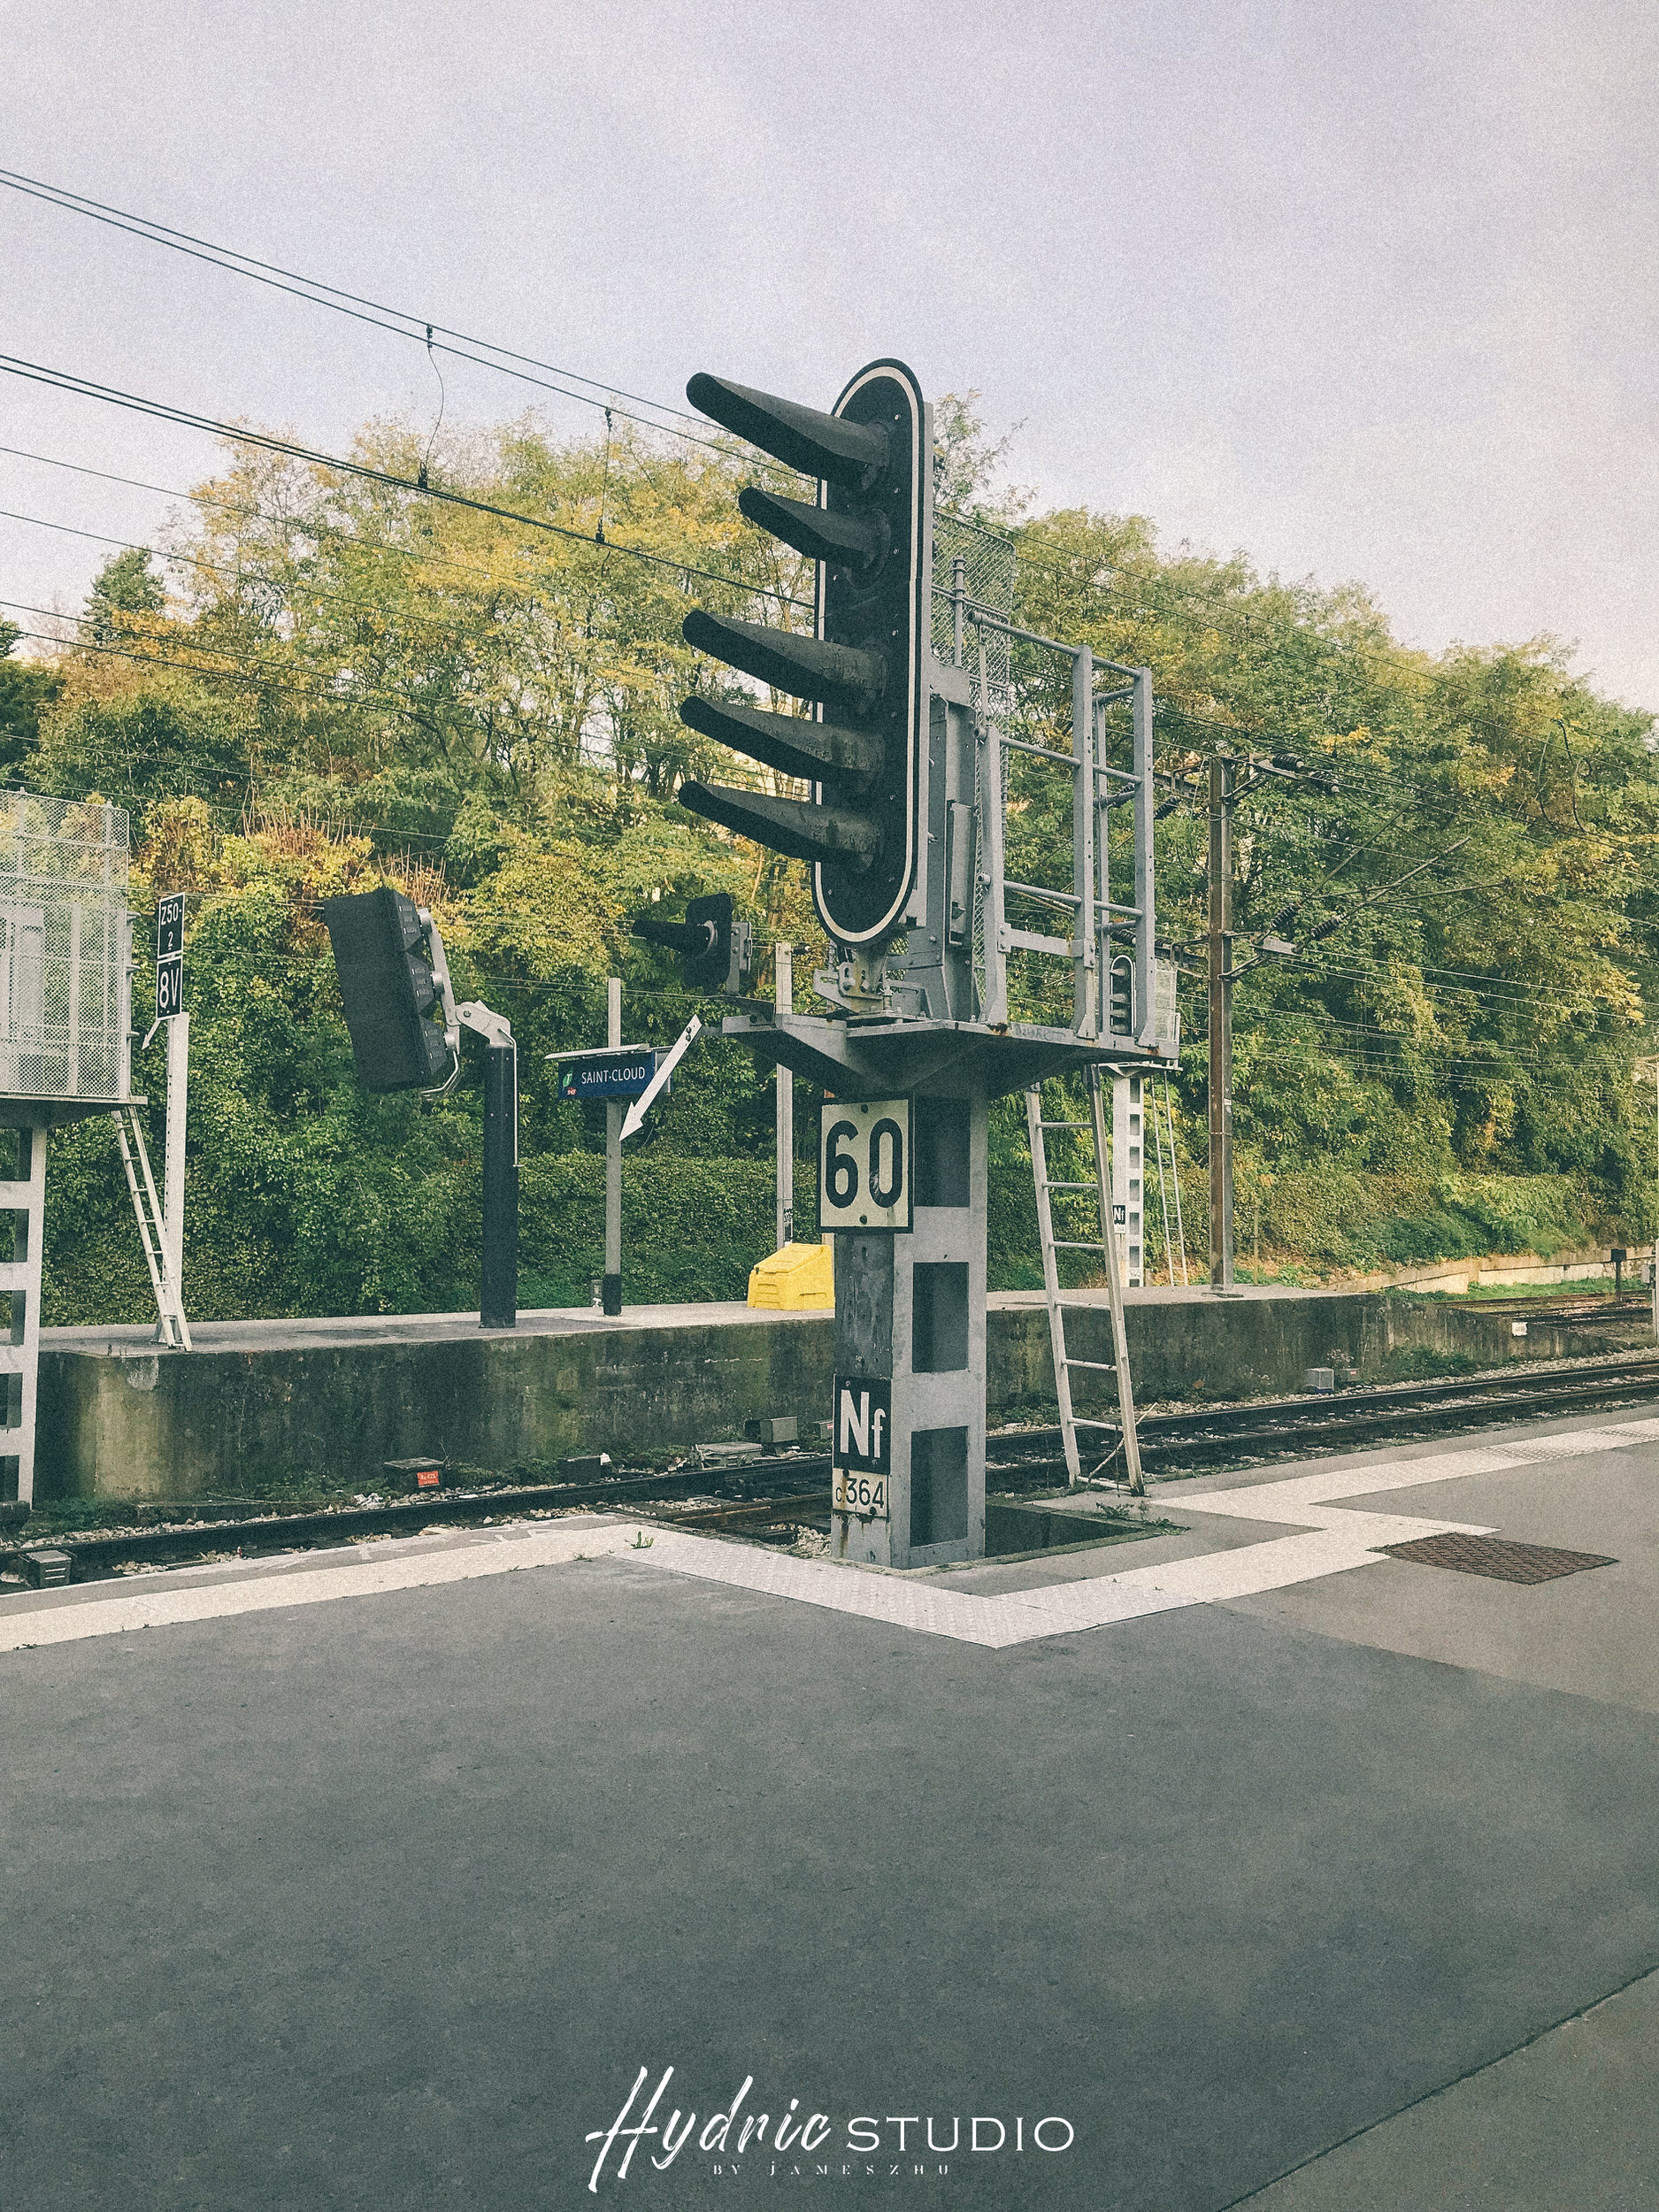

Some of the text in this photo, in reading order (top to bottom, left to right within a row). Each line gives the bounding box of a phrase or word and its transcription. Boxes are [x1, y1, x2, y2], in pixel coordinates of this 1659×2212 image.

[167, 931, 173, 948] 2
[159, 967, 180, 1009] 8V
[581, 1066, 646, 1085] SAINT-CLOUD
[825, 1118, 903, 1210] 60
[1113, 1207, 1125, 1222] Nf
[840, 1389, 887, 1459] Nf
